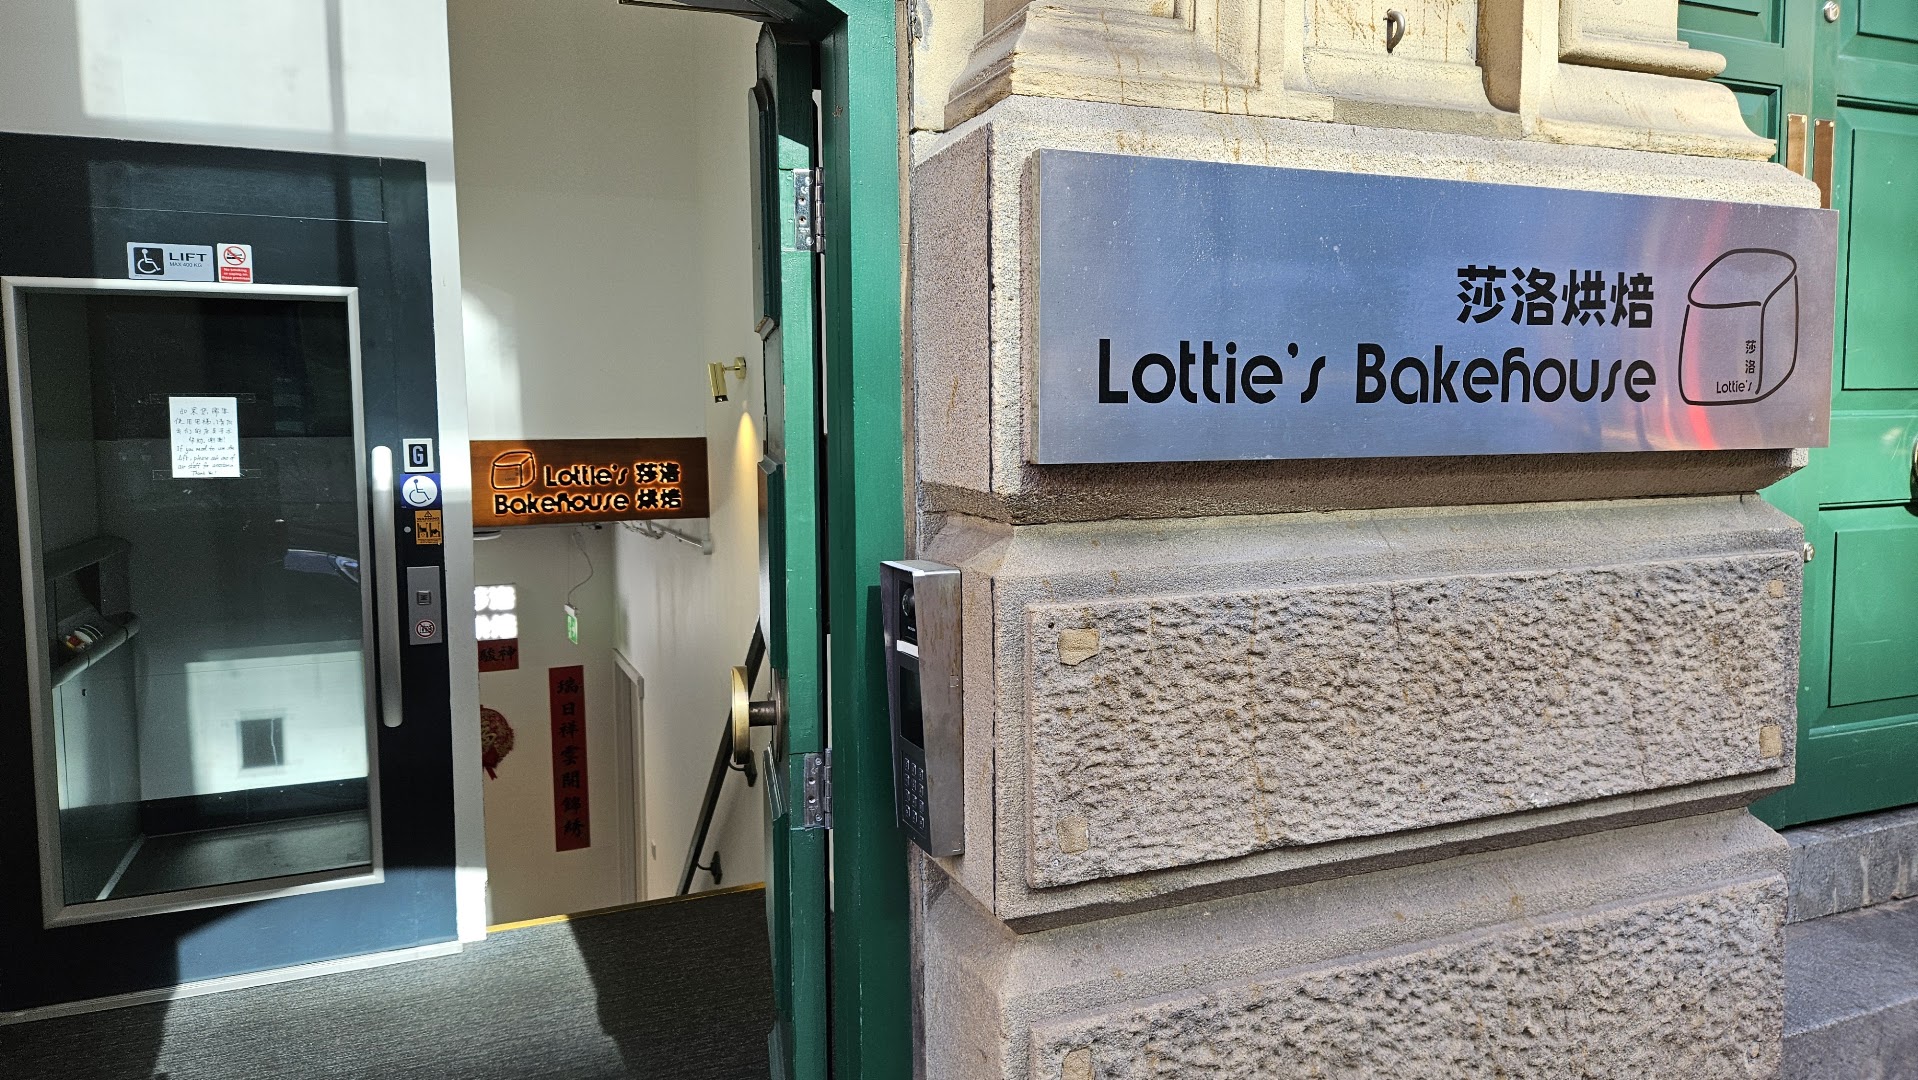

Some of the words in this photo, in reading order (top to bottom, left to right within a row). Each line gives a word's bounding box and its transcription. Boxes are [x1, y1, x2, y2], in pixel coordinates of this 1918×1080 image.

[169, 252, 207, 262] LIFT
[1457, 265, 1654, 328] 莎洛烘焙
[1745, 339, 1757, 374] 莎洛
[1099, 339, 1327, 404] Lottie's
[1356, 343, 1657, 404] Bakehouse
[1716, 380, 1753, 394] Lottie's
[412, 445, 424, 465] G
[543, 464, 629, 487] Lottie's
[494, 493, 629, 515] Bakehouse
